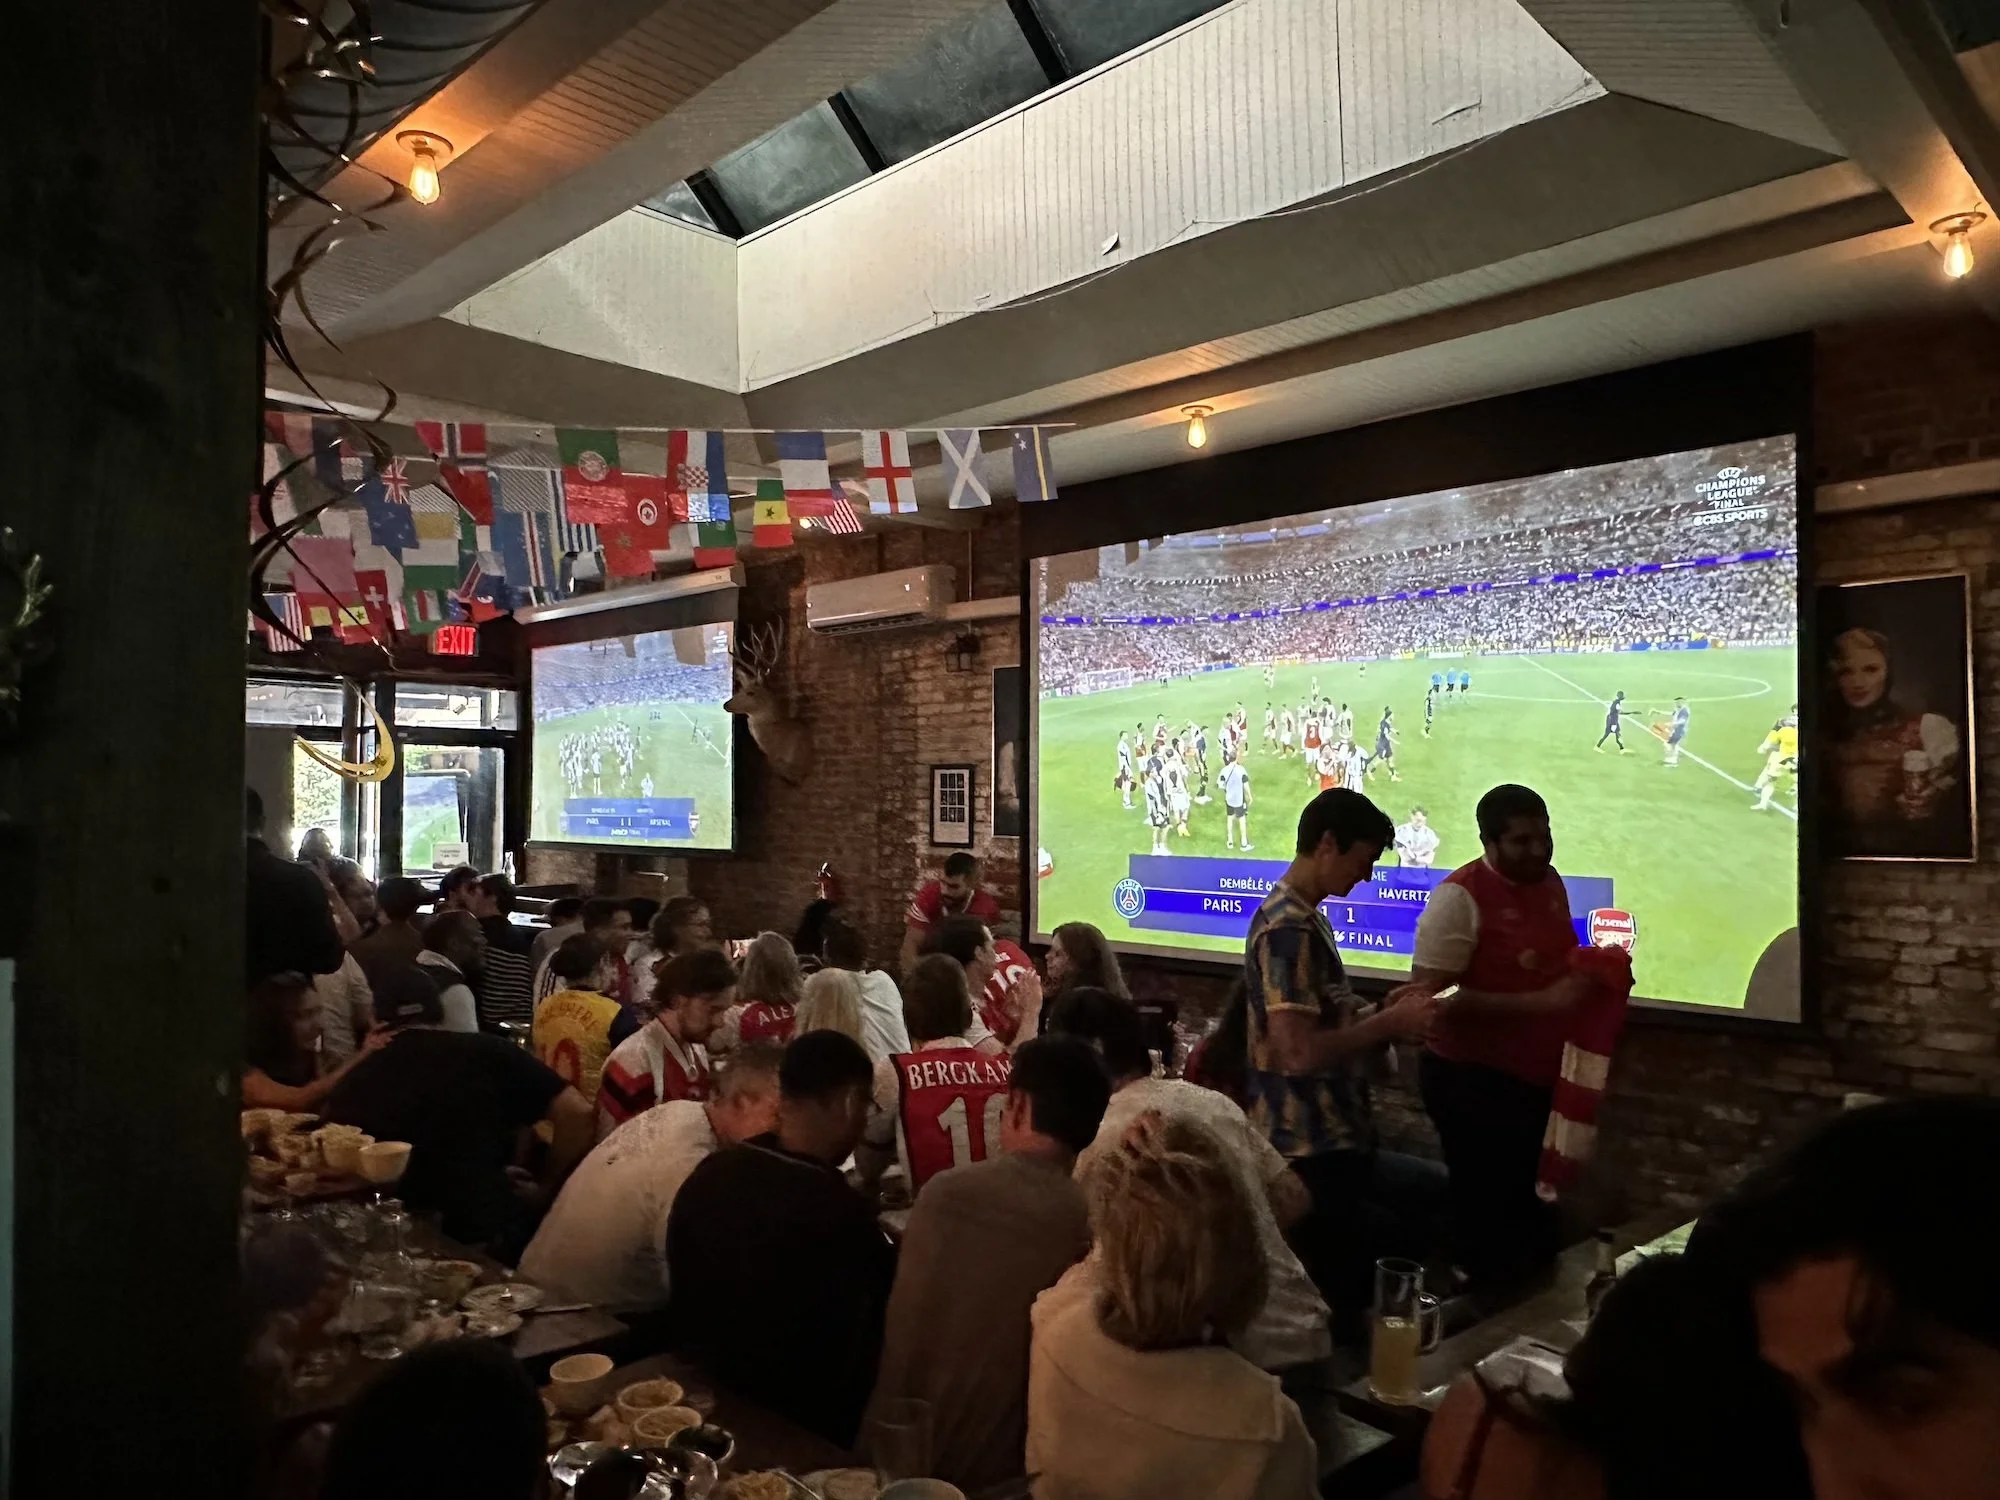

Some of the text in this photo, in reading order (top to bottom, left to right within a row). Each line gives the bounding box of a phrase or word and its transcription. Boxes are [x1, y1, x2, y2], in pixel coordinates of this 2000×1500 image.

[1695, 475, 1766, 493] CHAMPIONS
[1708, 486, 1754, 501] LEAGUE
[1702, 508, 1769, 526] CBS SPORTS
[438, 625, 476, 656] EXIT
[1219, 877, 1264, 891] DEMBÉLÉ
[1371, 871, 1387, 882] ME
[1378, 888, 1431, 903] HAVERTZ
[1203, 897, 1243, 913] PARIS
[1346, 907, 1356, 923] 1
[1593, 916, 1632, 929] Arsenal
[1348, 932, 1394, 948] FINAL
[758, 1005, 796, 1026] ALE
[906, 1060, 1012, 1090] BERGKAM
